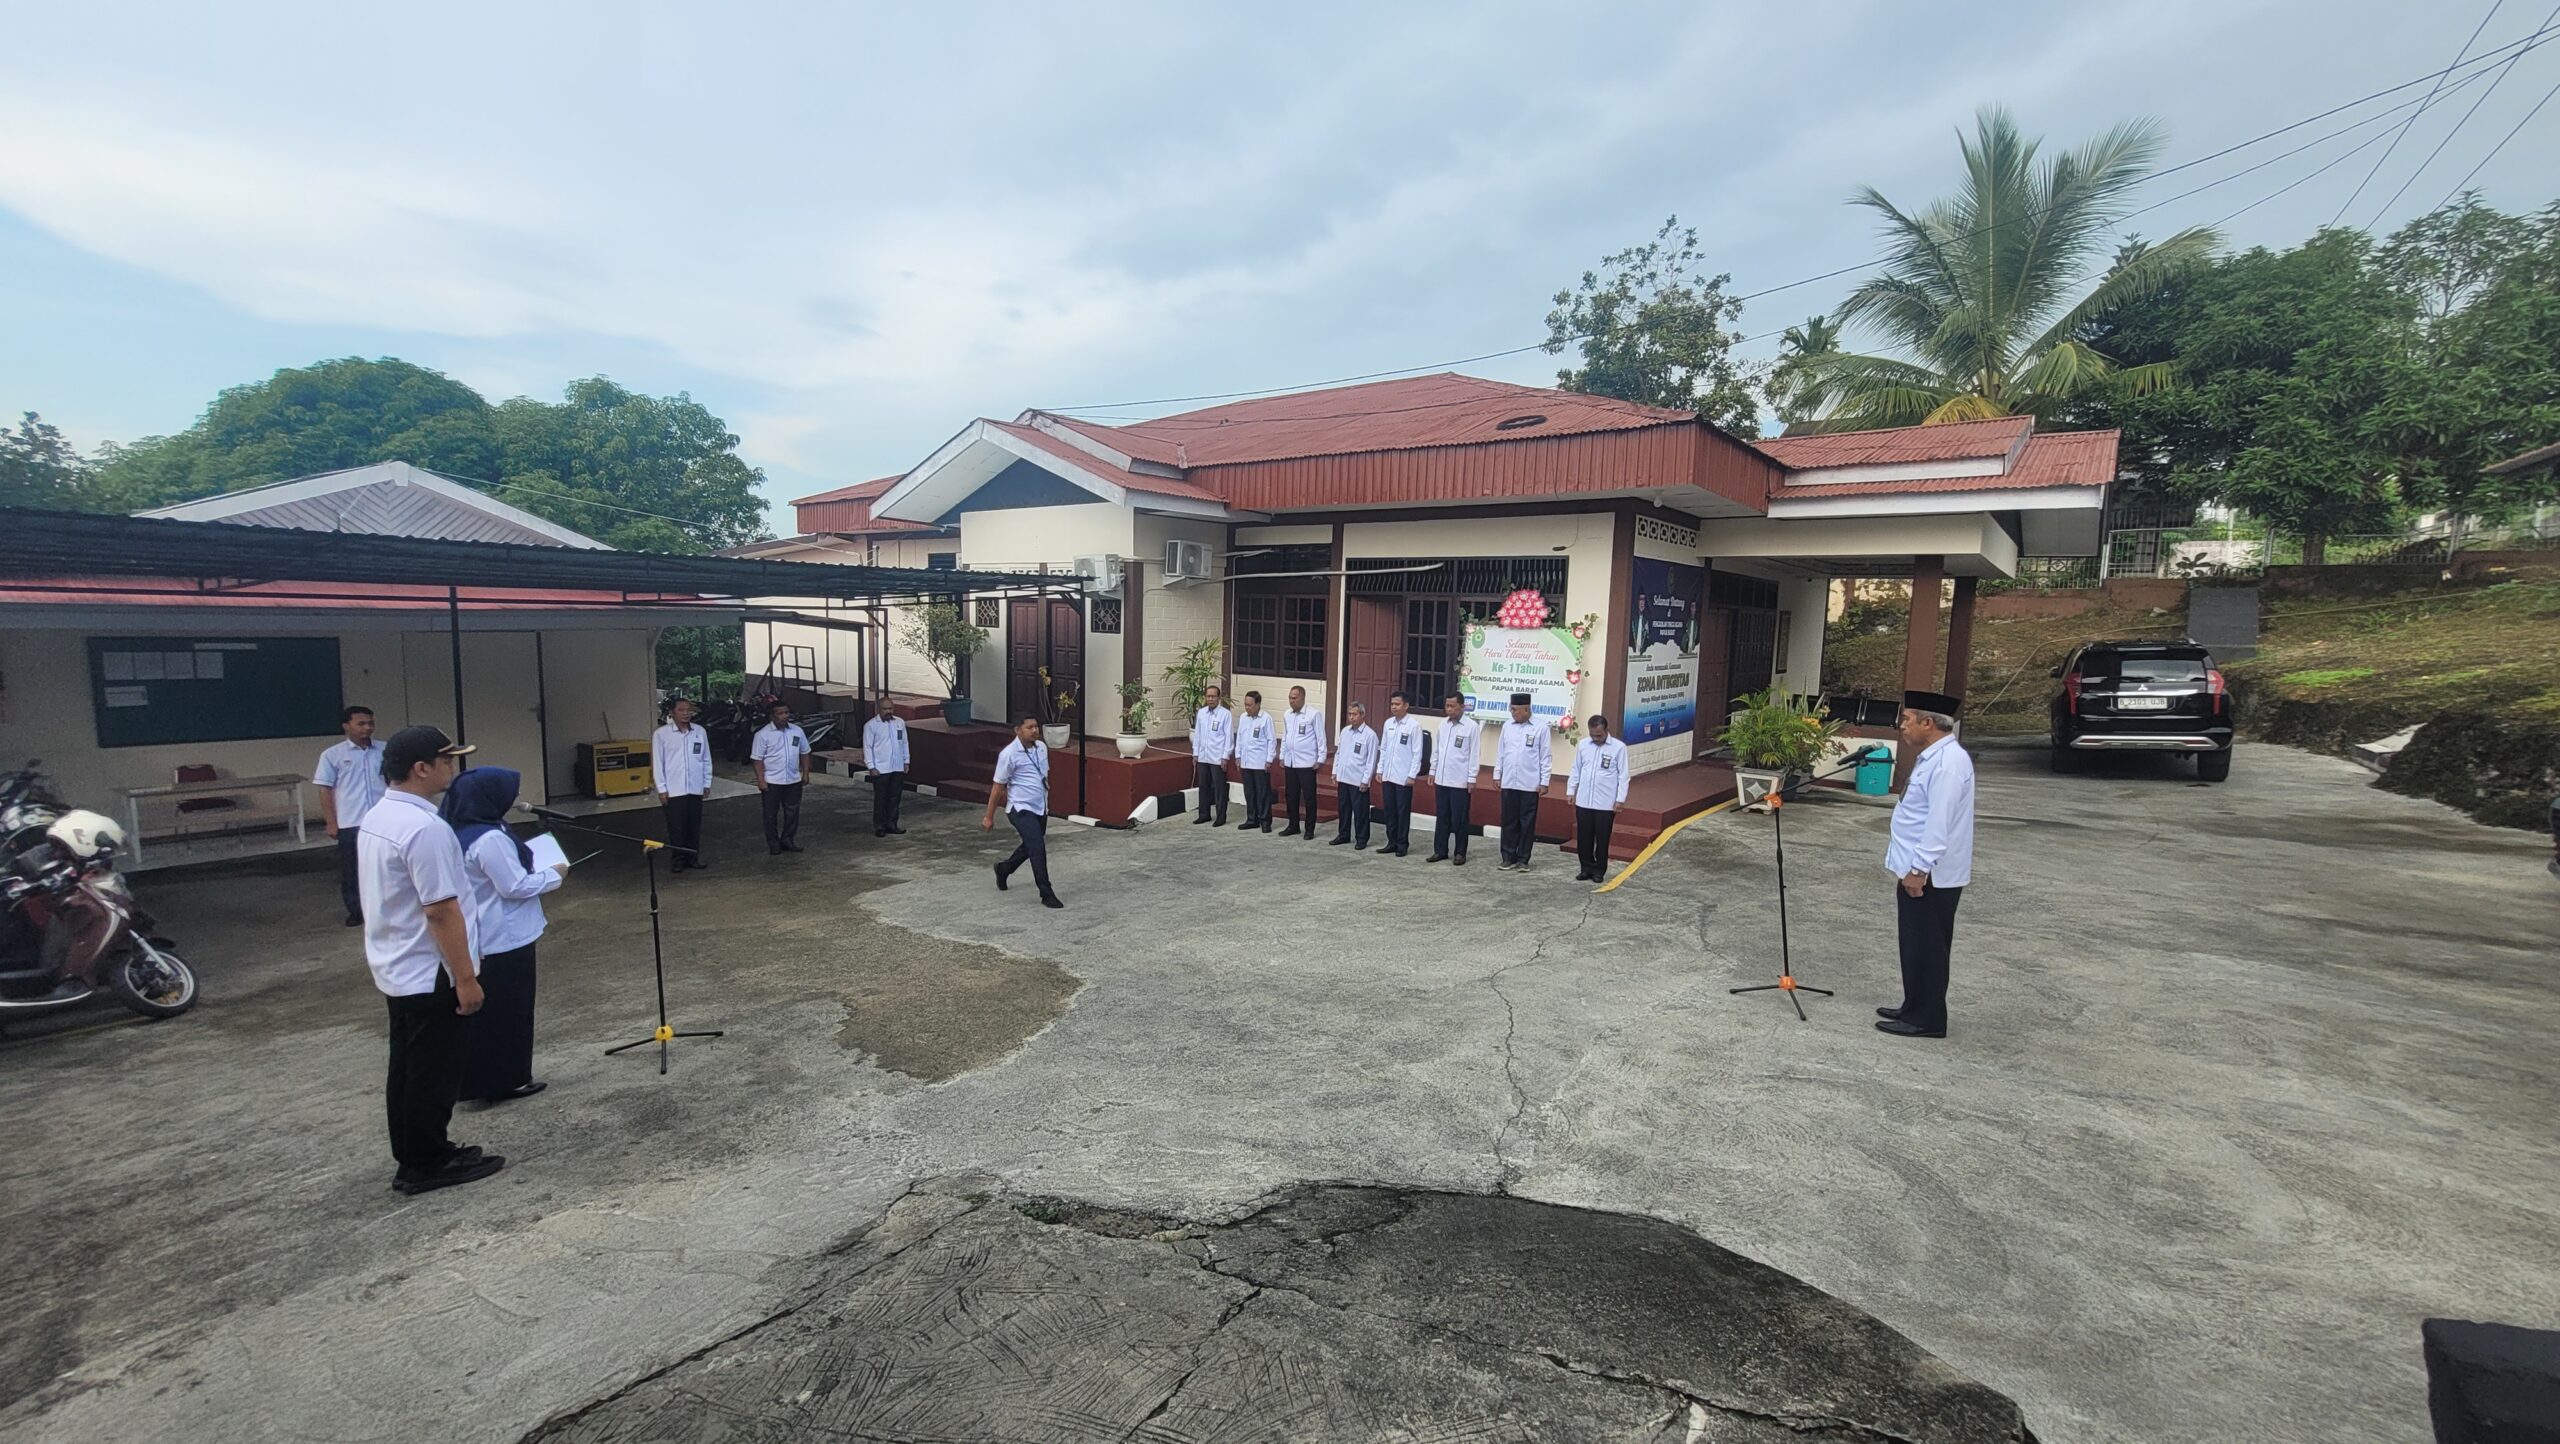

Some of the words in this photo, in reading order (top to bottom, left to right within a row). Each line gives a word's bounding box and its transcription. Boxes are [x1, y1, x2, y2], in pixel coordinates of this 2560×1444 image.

[1653, 594, 1670, 606] Selamat
[1505, 639, 1539, 650] Selamat
[1483, 648, 1502, 658] Hari
[1505, 649, 1531, 662] Ulang
[1534, 651, 1560, 661] Tahun
[1509, 662, 1513, 673] 1
[1515, 663, 1545, 675] Tahun
[1470, 675, 1512, 684] PENGADILAN
[1637, 675, 1655, 692] ZONA
[1656, 672, 1690, 690] INTEGRITAS
[1492, 685, 1514, 693] PAPUA
[1477, 700, 1487, 710] BRI
[1487, 701, 1508, 711] KANTOR
[1531, 704, 1567, 716] MANOKWARI
